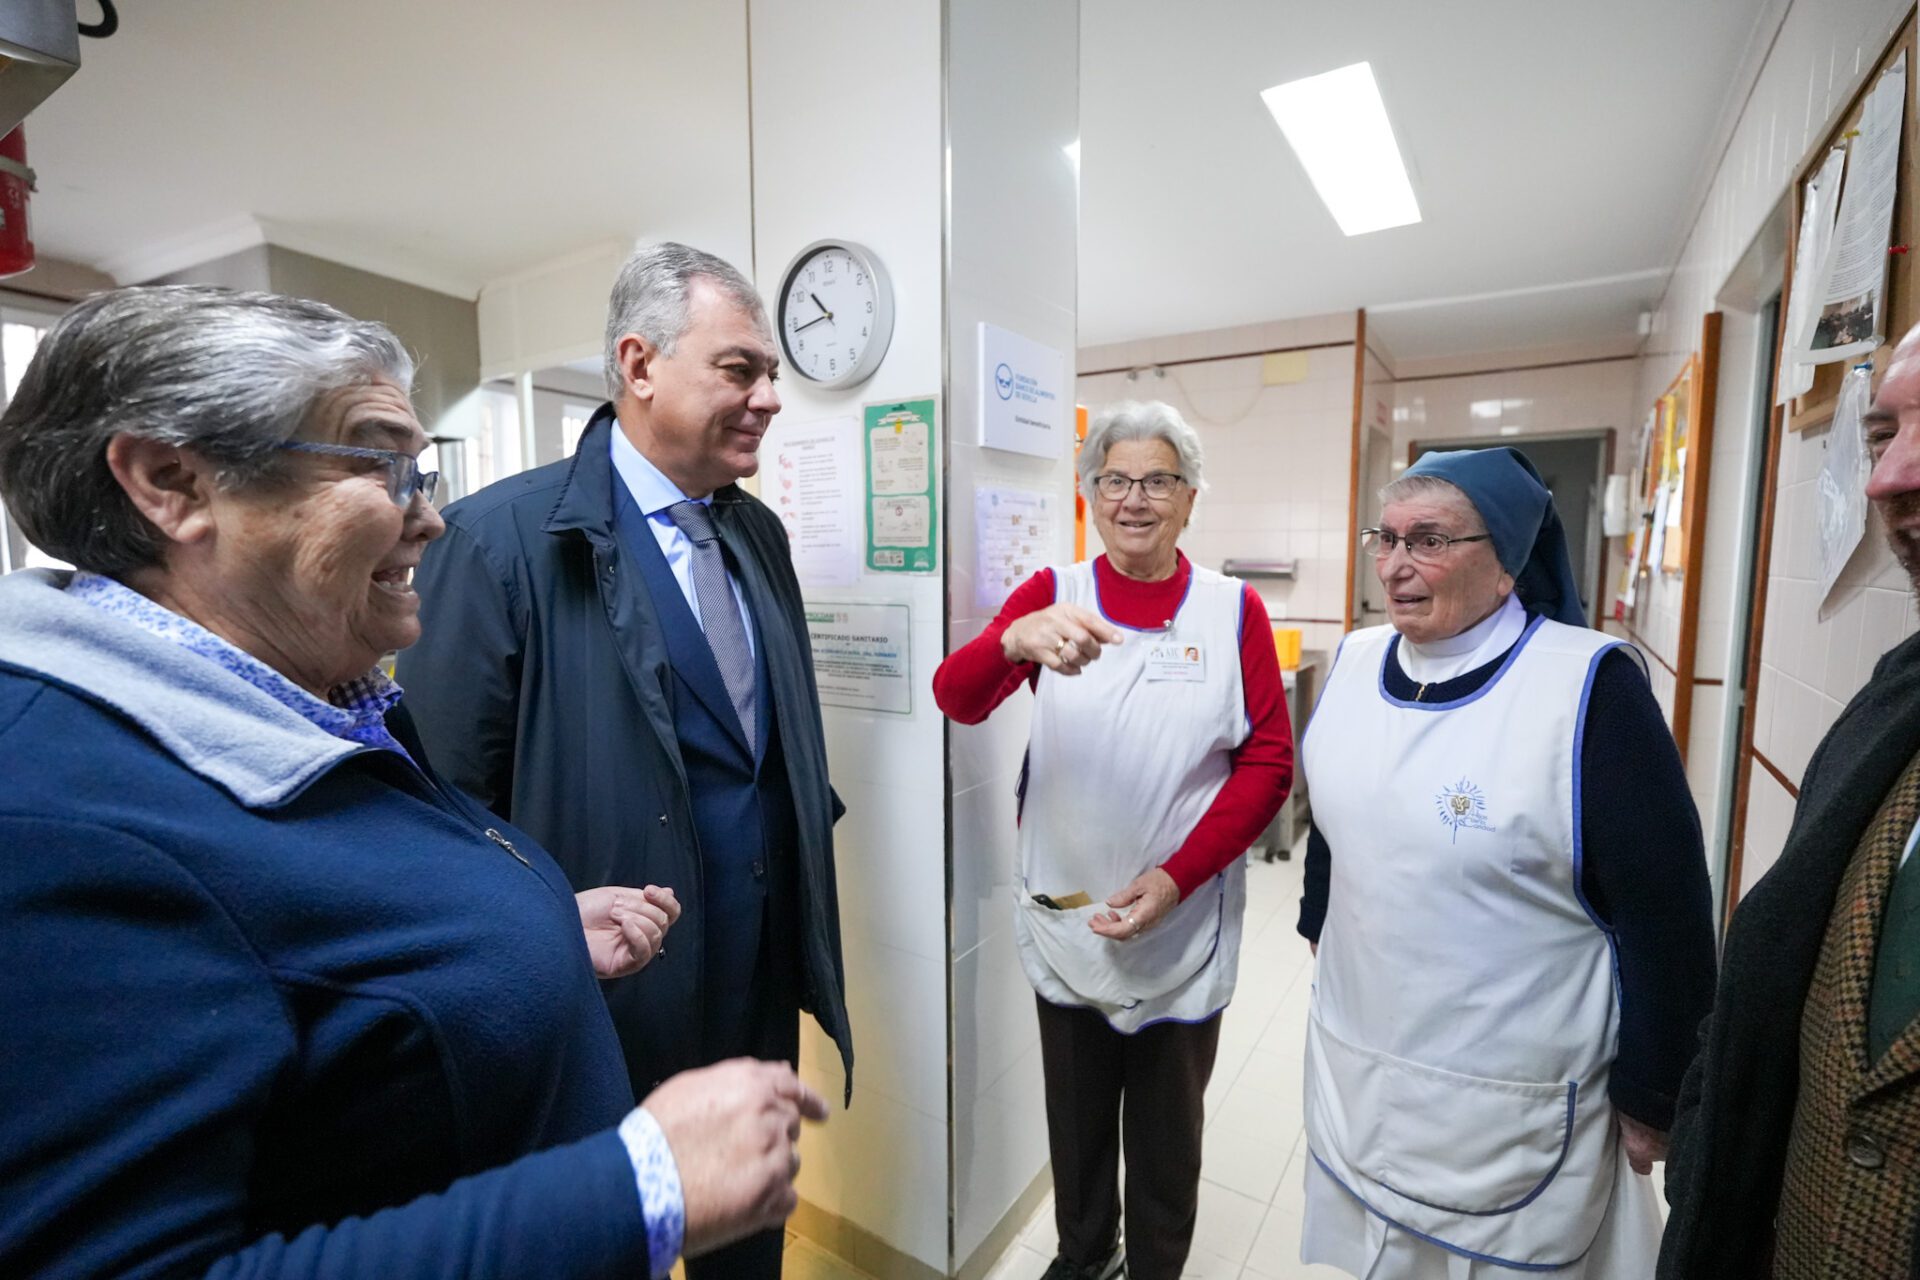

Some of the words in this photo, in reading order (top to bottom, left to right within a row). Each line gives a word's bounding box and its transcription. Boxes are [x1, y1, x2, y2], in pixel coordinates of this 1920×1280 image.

[823, 259, 833, 273] 12
[808, 271, 816, 283] 11
[856, 273, 863, 286] 2
[796, 290, 805, 303] 10
[866, 301, 873, 314] 3
[792, 316, 799, 330] 9
[862, 325, 868, 337] 4
[798, 339, 805, 351] 8
[813, 353, 819, 366] 7
[849, 347, 856, 361] 5
[829, 358, 836, 371] 6
[810, 632, 850, 642] CERTIFICADO
[852, 635, 889, 644] SANITARIO
